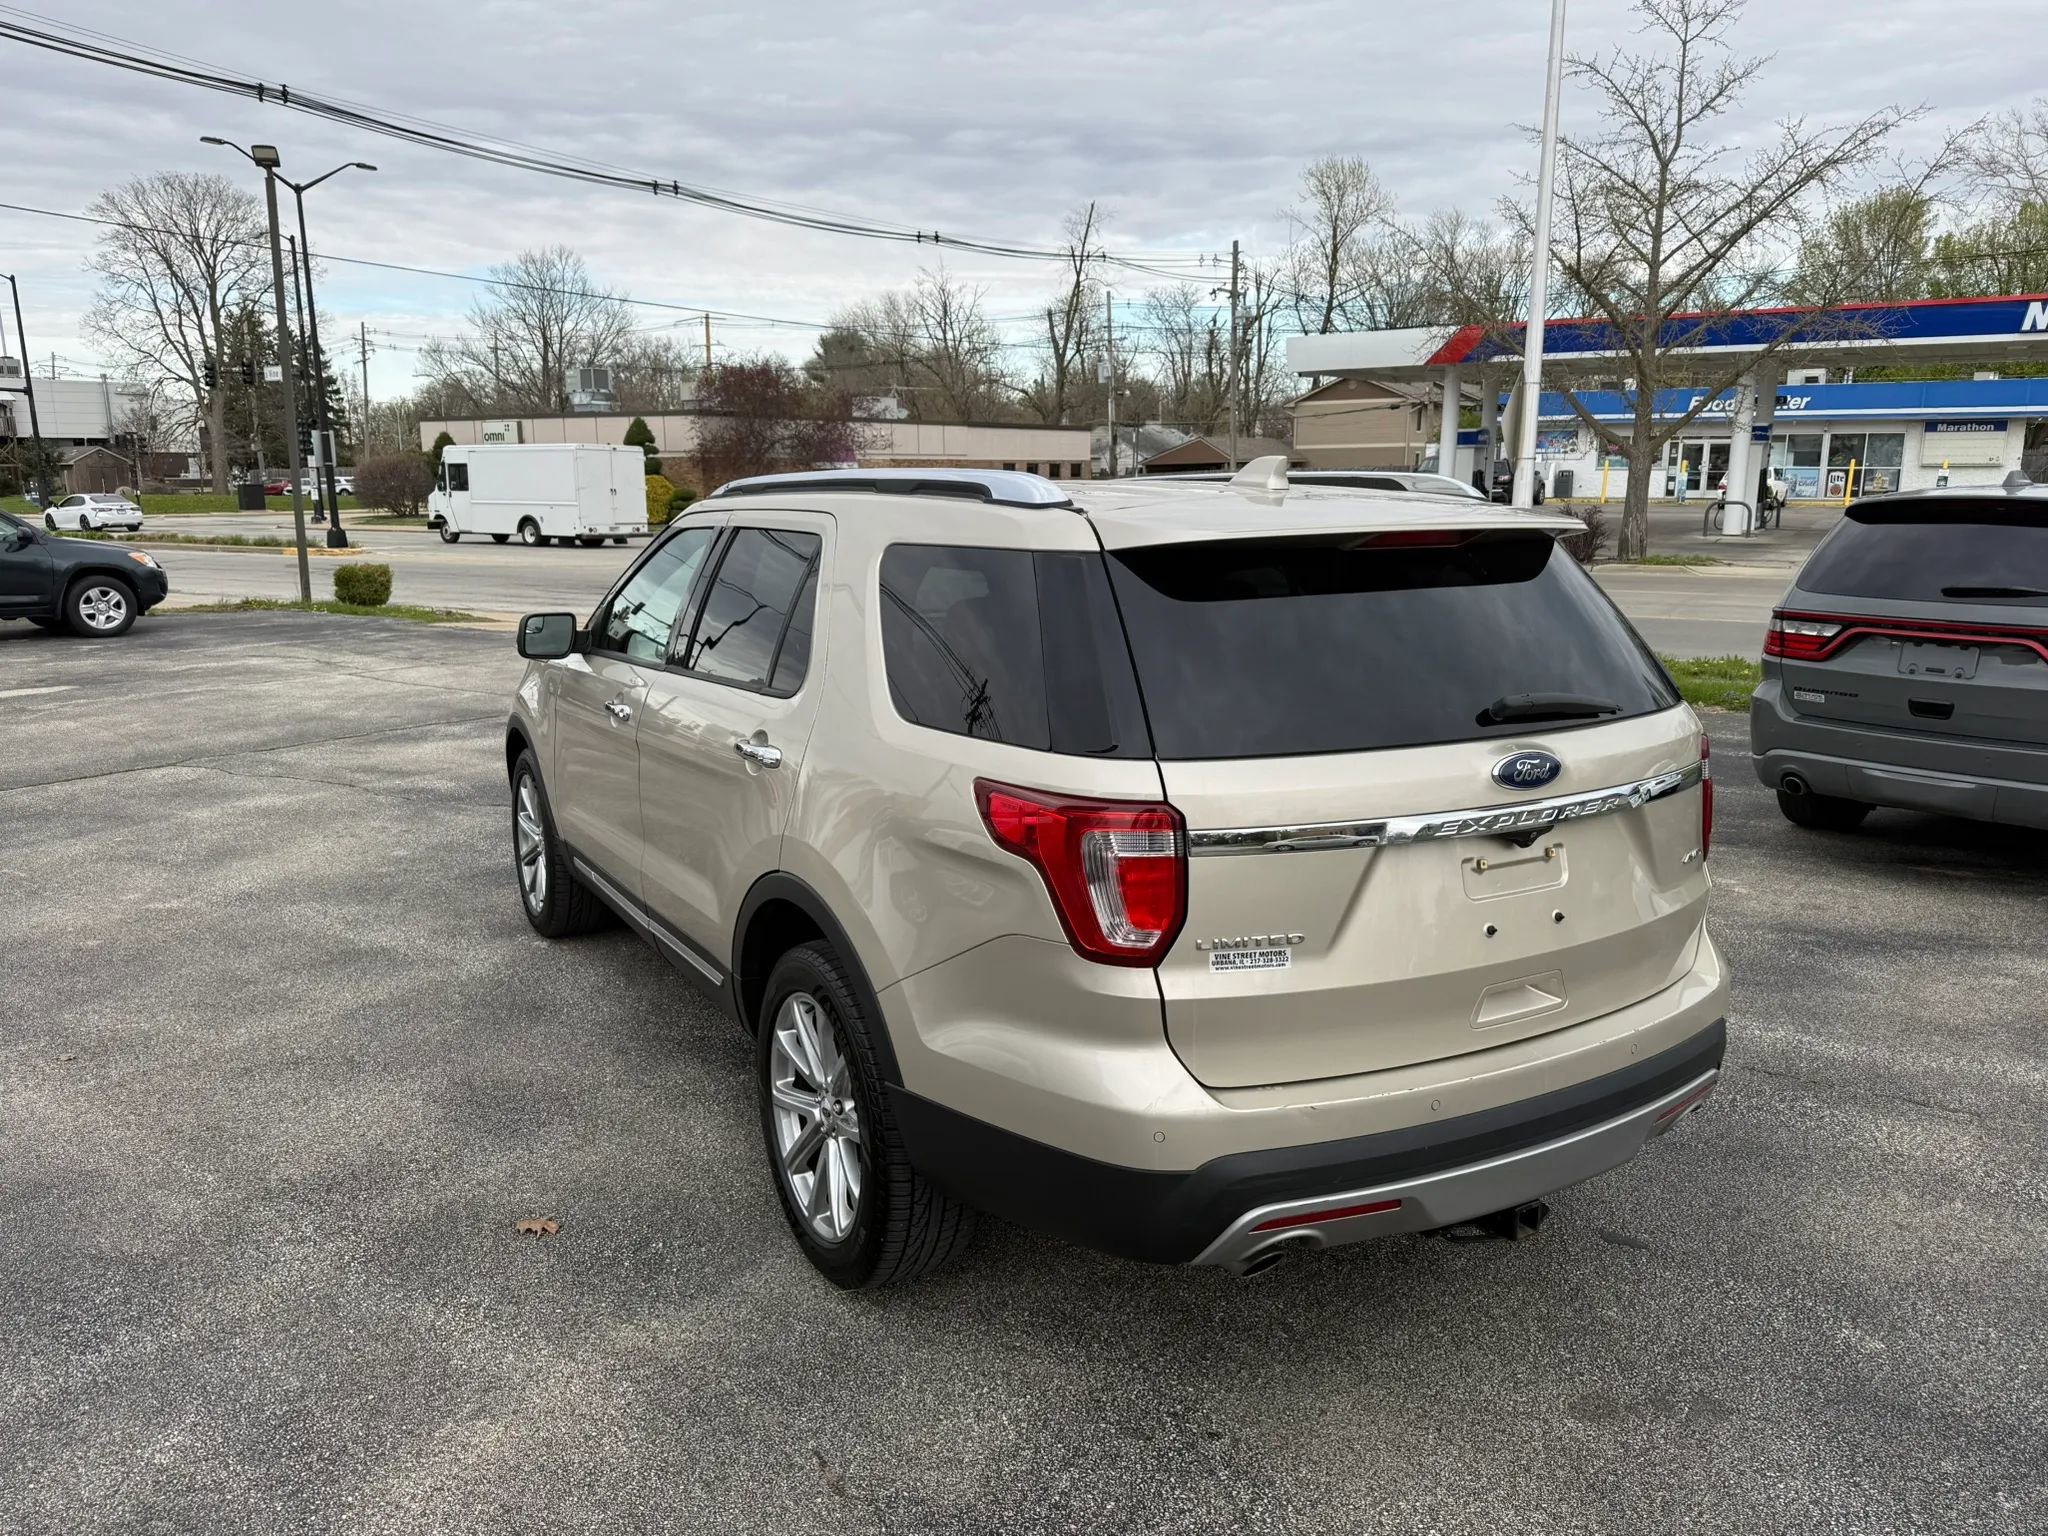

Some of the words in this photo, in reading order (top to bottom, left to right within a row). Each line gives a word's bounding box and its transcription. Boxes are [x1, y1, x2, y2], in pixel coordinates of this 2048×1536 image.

[1936, 423, 1995, 432] Marathon
[483, 432, 505, 442] omni
[1830, 474, 1845, 484] Lite
[1513, 759, 1550, 782] Ford
[1434, 798, 1620, 837] EXPLORER
[1195, 933, 1305, 951] LIMITED
[1232, 951, 1257, 960] STREET
[1259, 949, 1287, 958] MOTORS
